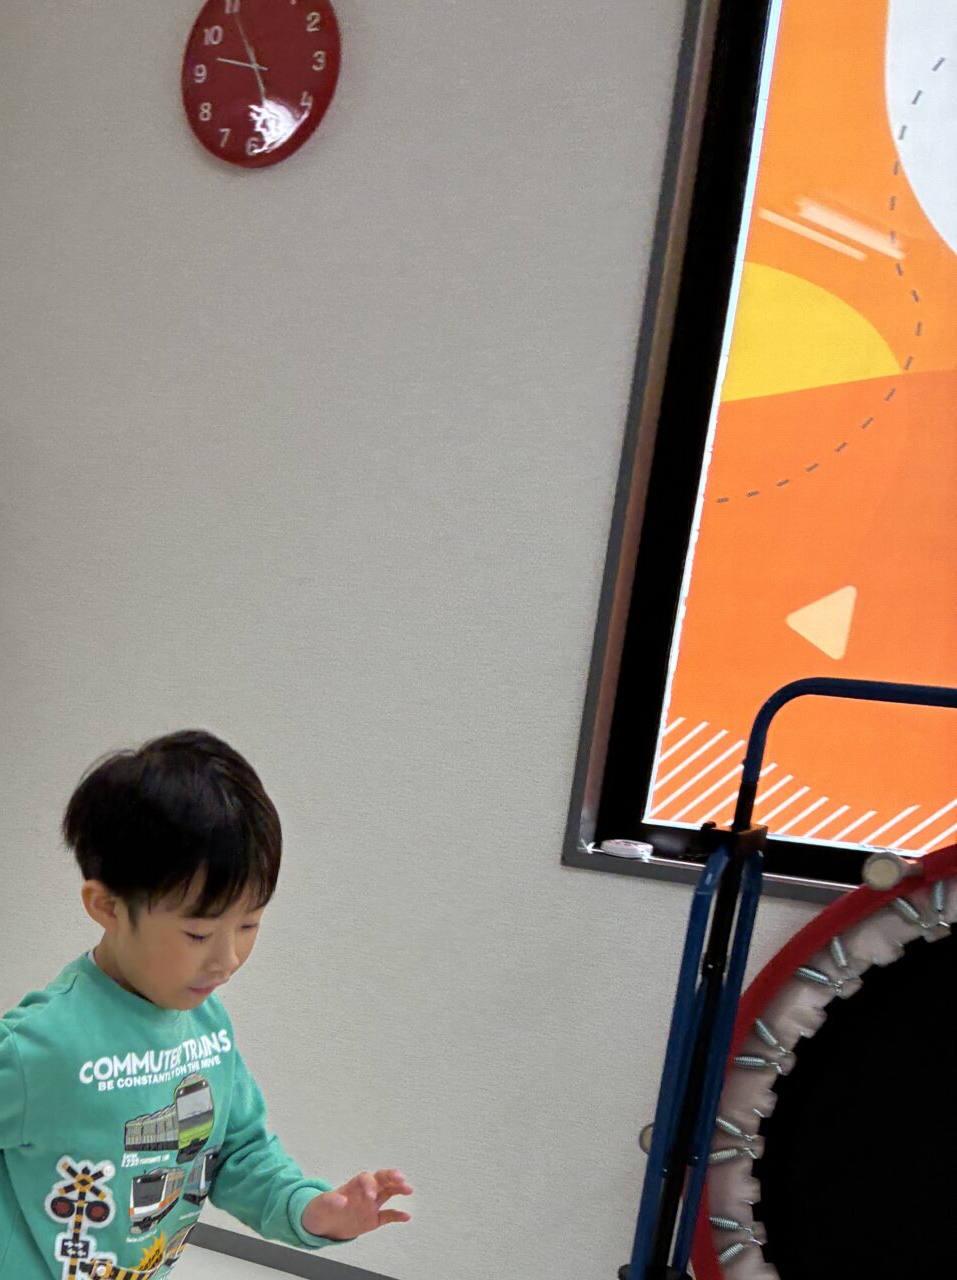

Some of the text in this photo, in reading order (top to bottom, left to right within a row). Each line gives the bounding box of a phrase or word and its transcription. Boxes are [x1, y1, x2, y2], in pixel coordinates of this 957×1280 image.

[306, 12, 321, 32] 2
[203, 25, 223, 45] 10
[312, 50, 326, 71] 3
[194, 64, 207, 83] 9
[199, 102, 212, 121] 8
[219, 128, 231, 147] 7
[79, 1028, 232, 1084] COMMUTER TRAINS
[98, 1081, 115, 1092] BE
[175, 1066, 187, 1076] ON
